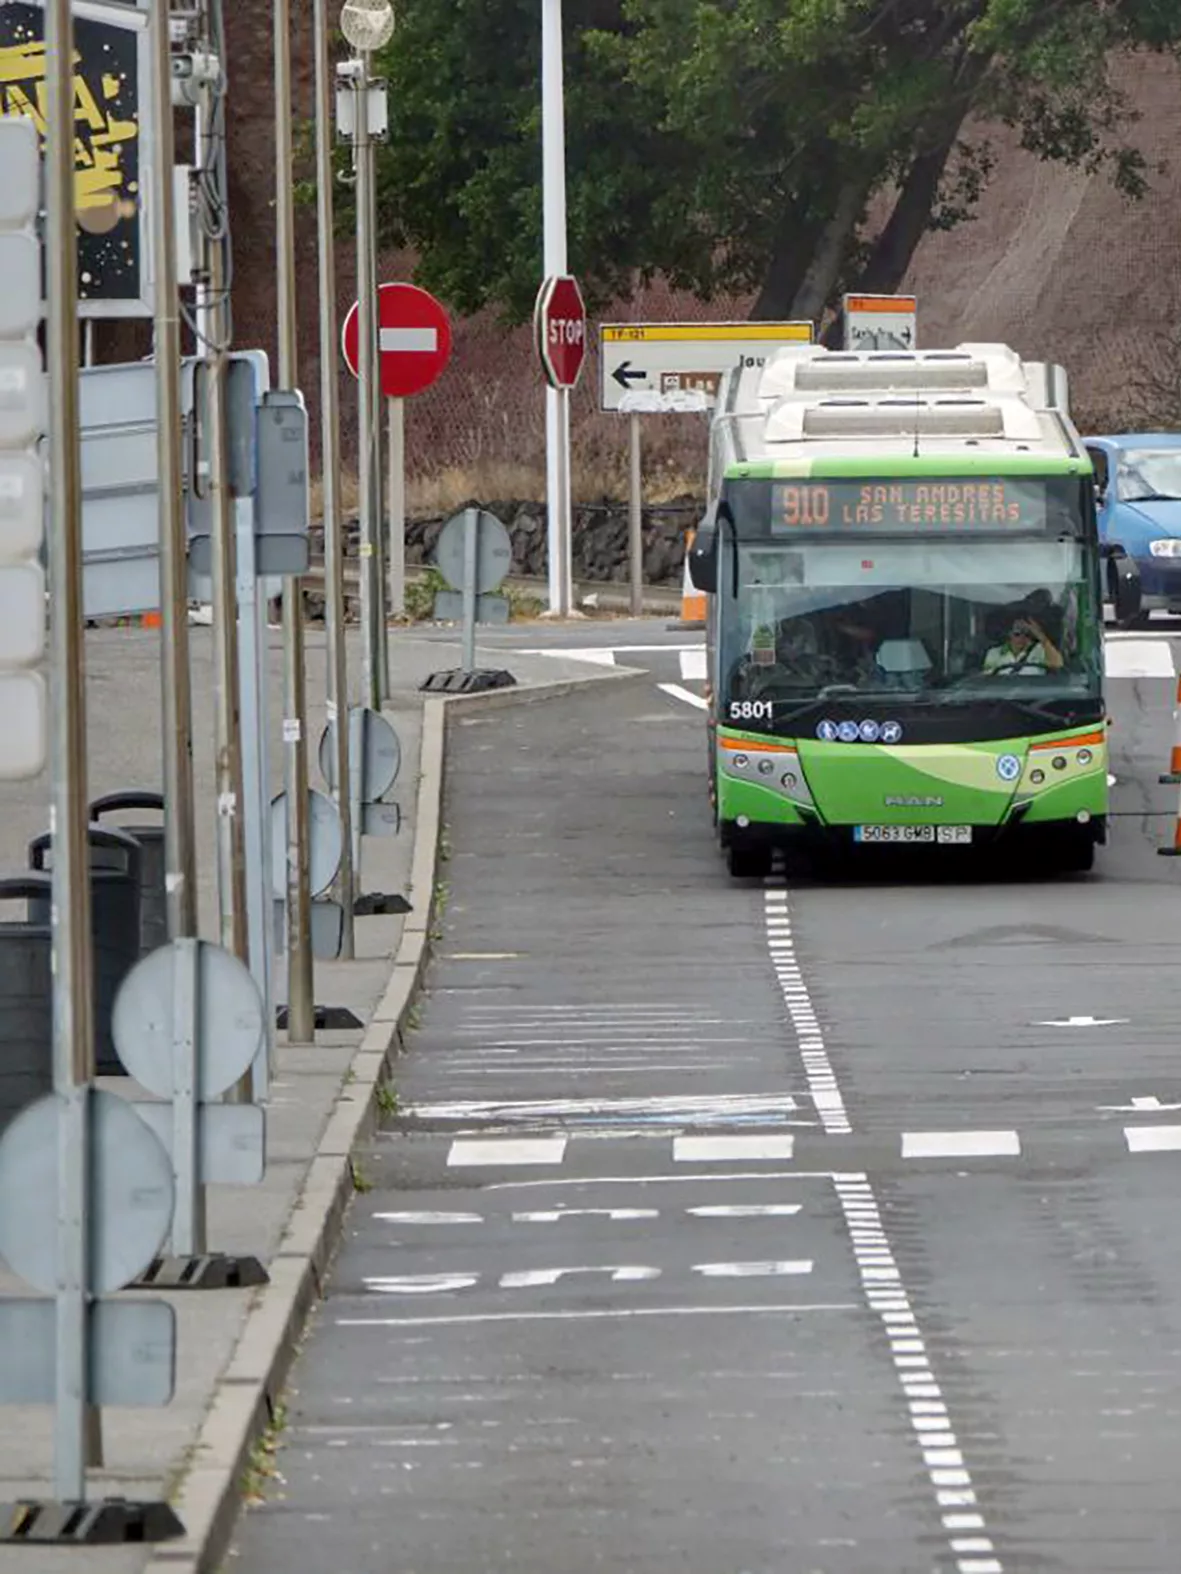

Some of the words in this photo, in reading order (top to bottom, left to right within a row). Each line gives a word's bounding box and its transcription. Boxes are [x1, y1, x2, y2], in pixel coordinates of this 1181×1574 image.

[549, 318, 583, 346] STOP
[860, 485, 903, 503] SAN
[916, 485, 1005, 503] ANDRES
[783, 487, 829, 525] 910
[843, 504, 884, 523] LAS
[899, 503, 1020, 523] TERESITAS
[730, 700, 773, 719] 5801
